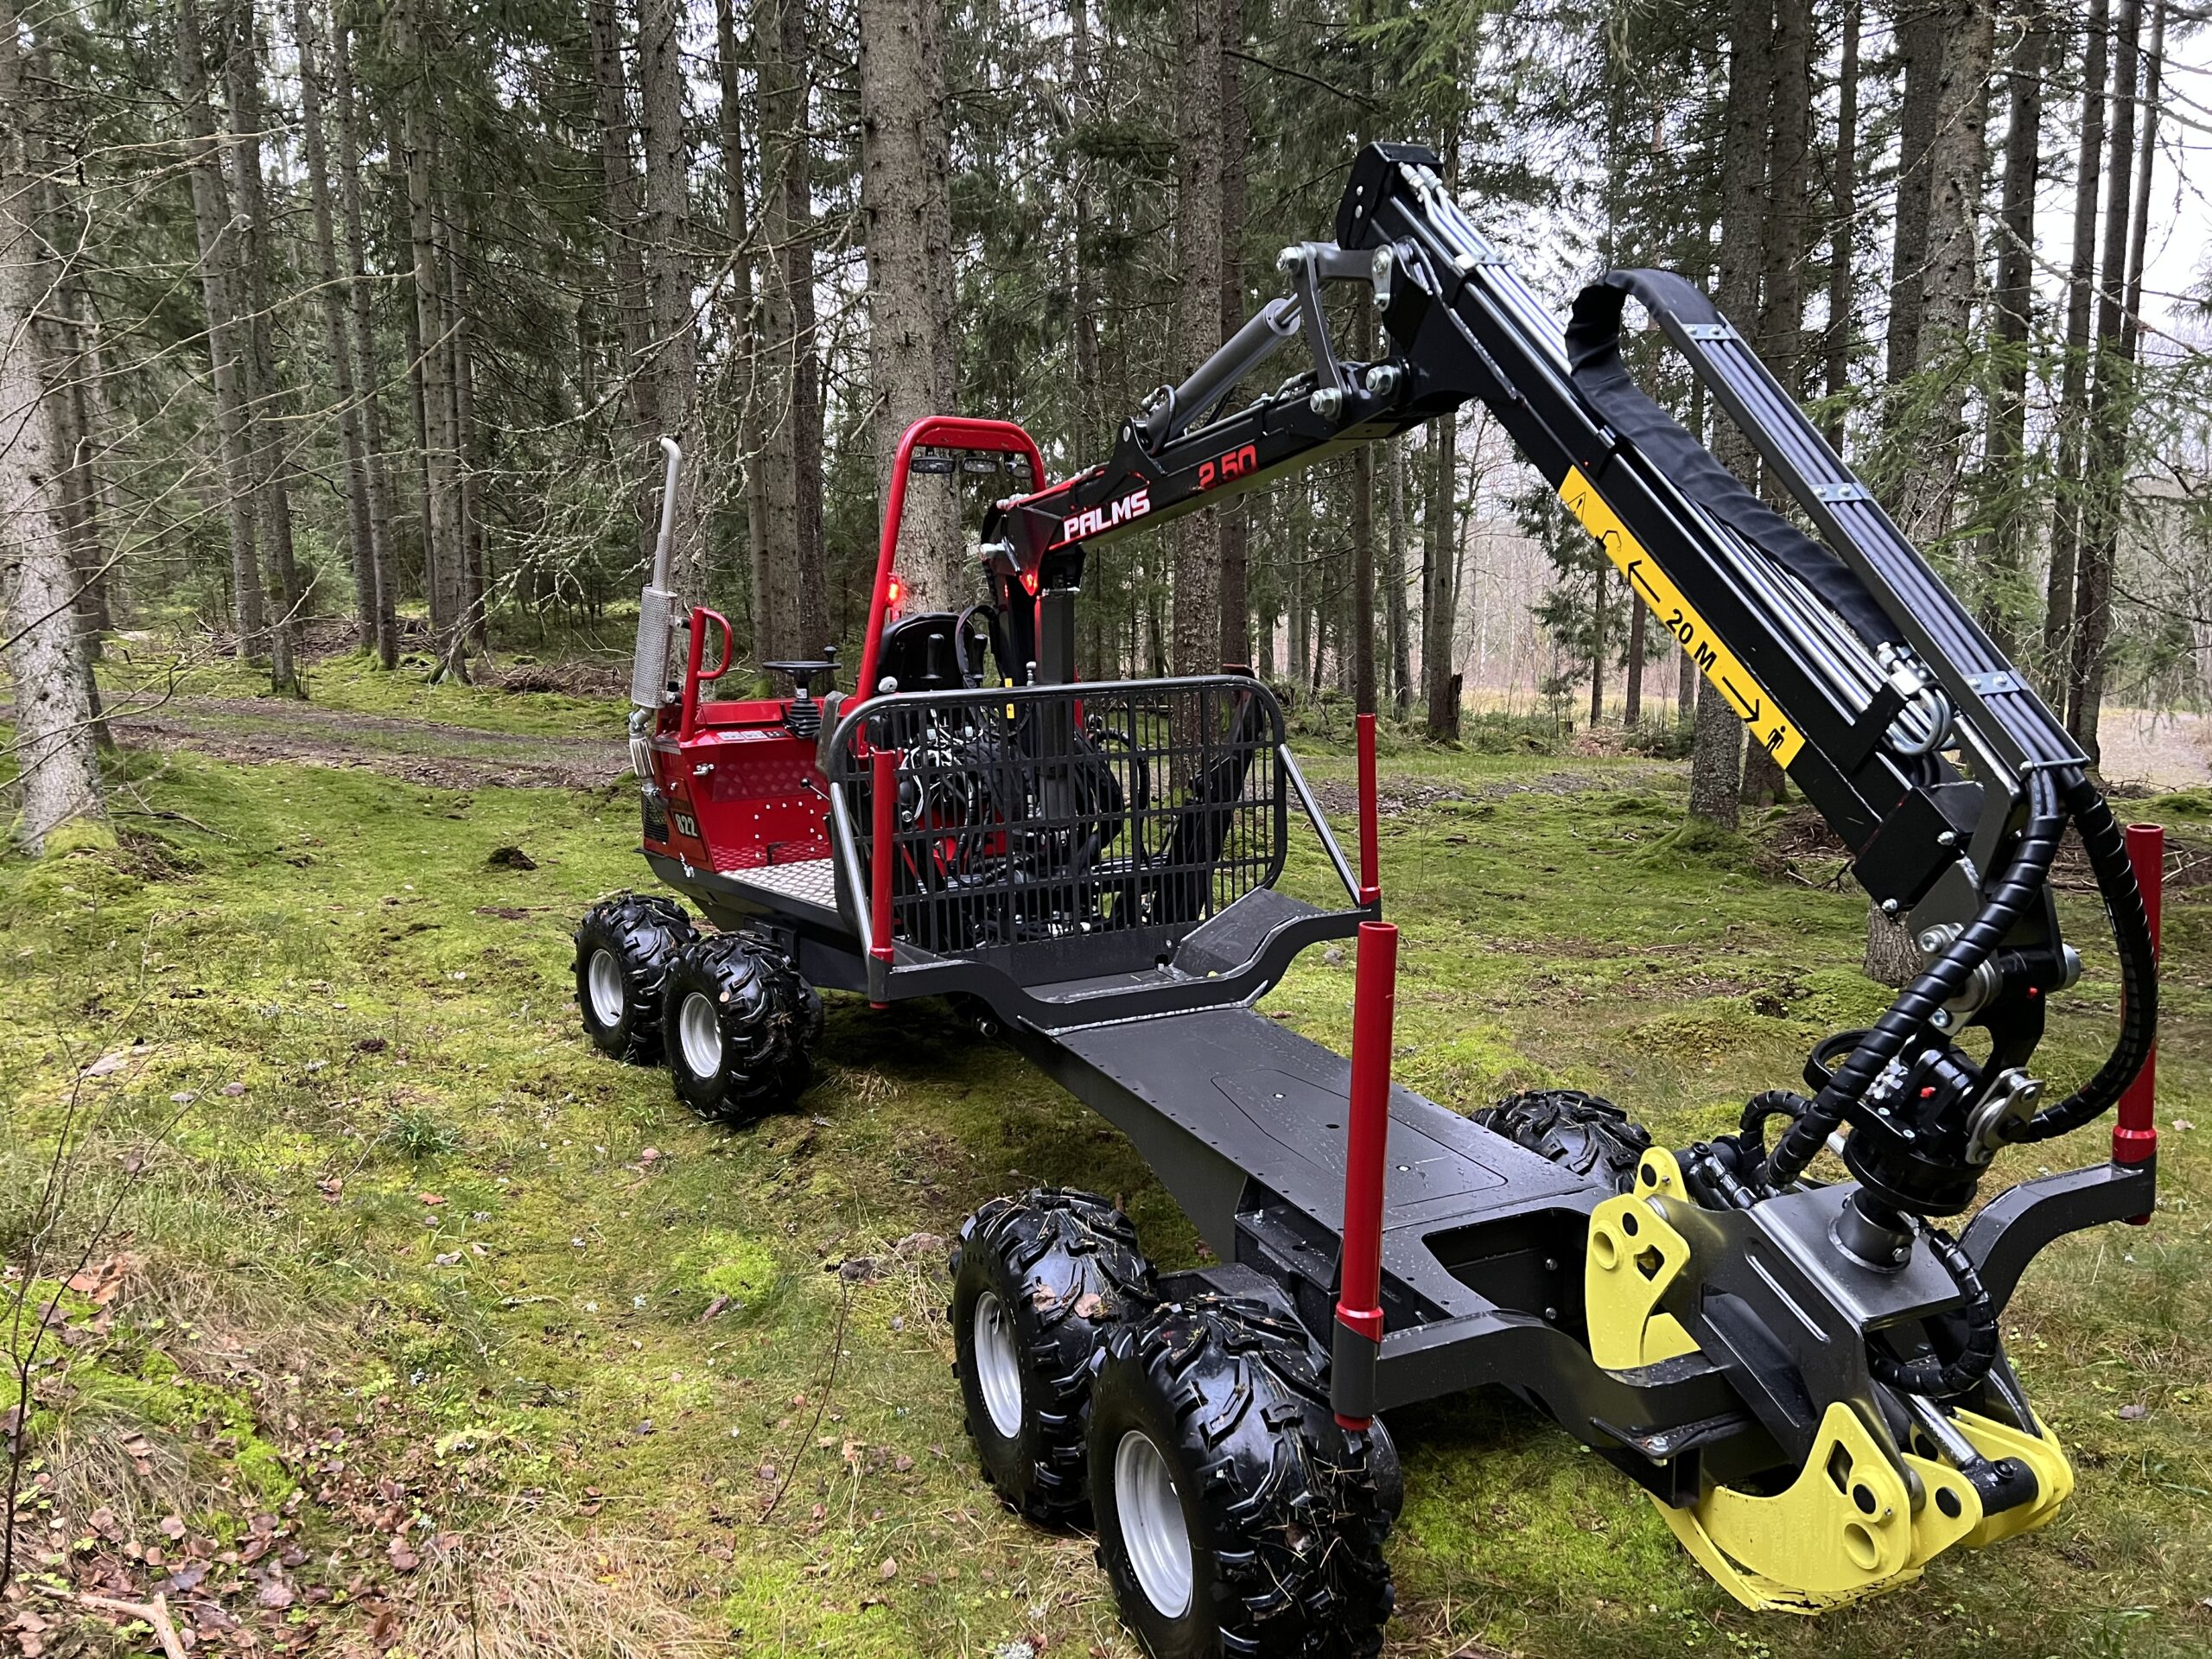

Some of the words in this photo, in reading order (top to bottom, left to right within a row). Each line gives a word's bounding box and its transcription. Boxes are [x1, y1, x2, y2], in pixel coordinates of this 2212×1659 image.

[1064, 488, 1151, 542] PALMS
[1666, 608, 1694, 645] 20
[1694, 640, 1718, 672] M
[675, 813, 698, 837] 822
